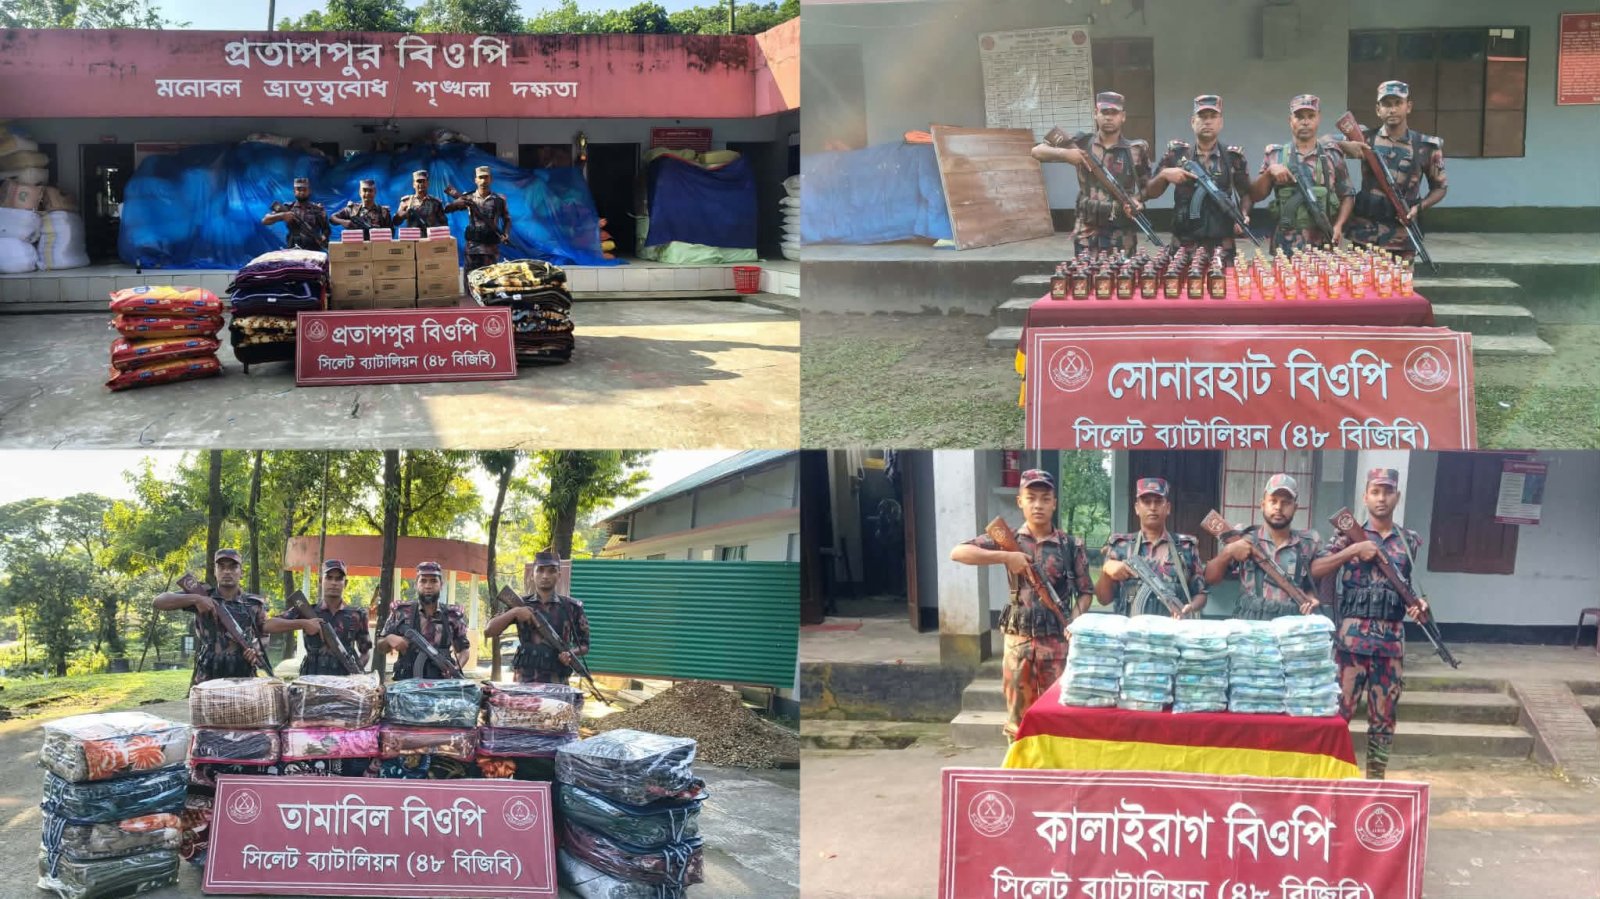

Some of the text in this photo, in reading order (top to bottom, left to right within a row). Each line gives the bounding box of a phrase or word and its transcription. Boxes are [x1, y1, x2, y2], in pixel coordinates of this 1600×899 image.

[224, 37, 383, 80] প্রতাপপুর
[154, 78, 578, 107] মনোবল ভ্রাতৃত্ববোধ শৃঙ্খলা দক্ষতা
[331, 316, 479, 349] প্রতাপপুর বিওপি
[317, 350, 497, 372] সিলেট ব্যাটালিয়ন (৪৮ বিজিবি)
[1107, 347, 1394, 406] সোনারহাট বিওপি
[1072, 415, 1430, 450] সিলেট ব্যাটালিয়ন (৪৮ বিজিবি)
[276, 793, 488, 839] তামাবিল বিওপি
[1031, 797, 1338, 864] কালাইরাগ বিওপি
[241, 844, 523, 881] সিলেট ব্যাটালিয়ন (৪৮ বিজিবি)
[990, 866, 1073, 899] সিলেট
